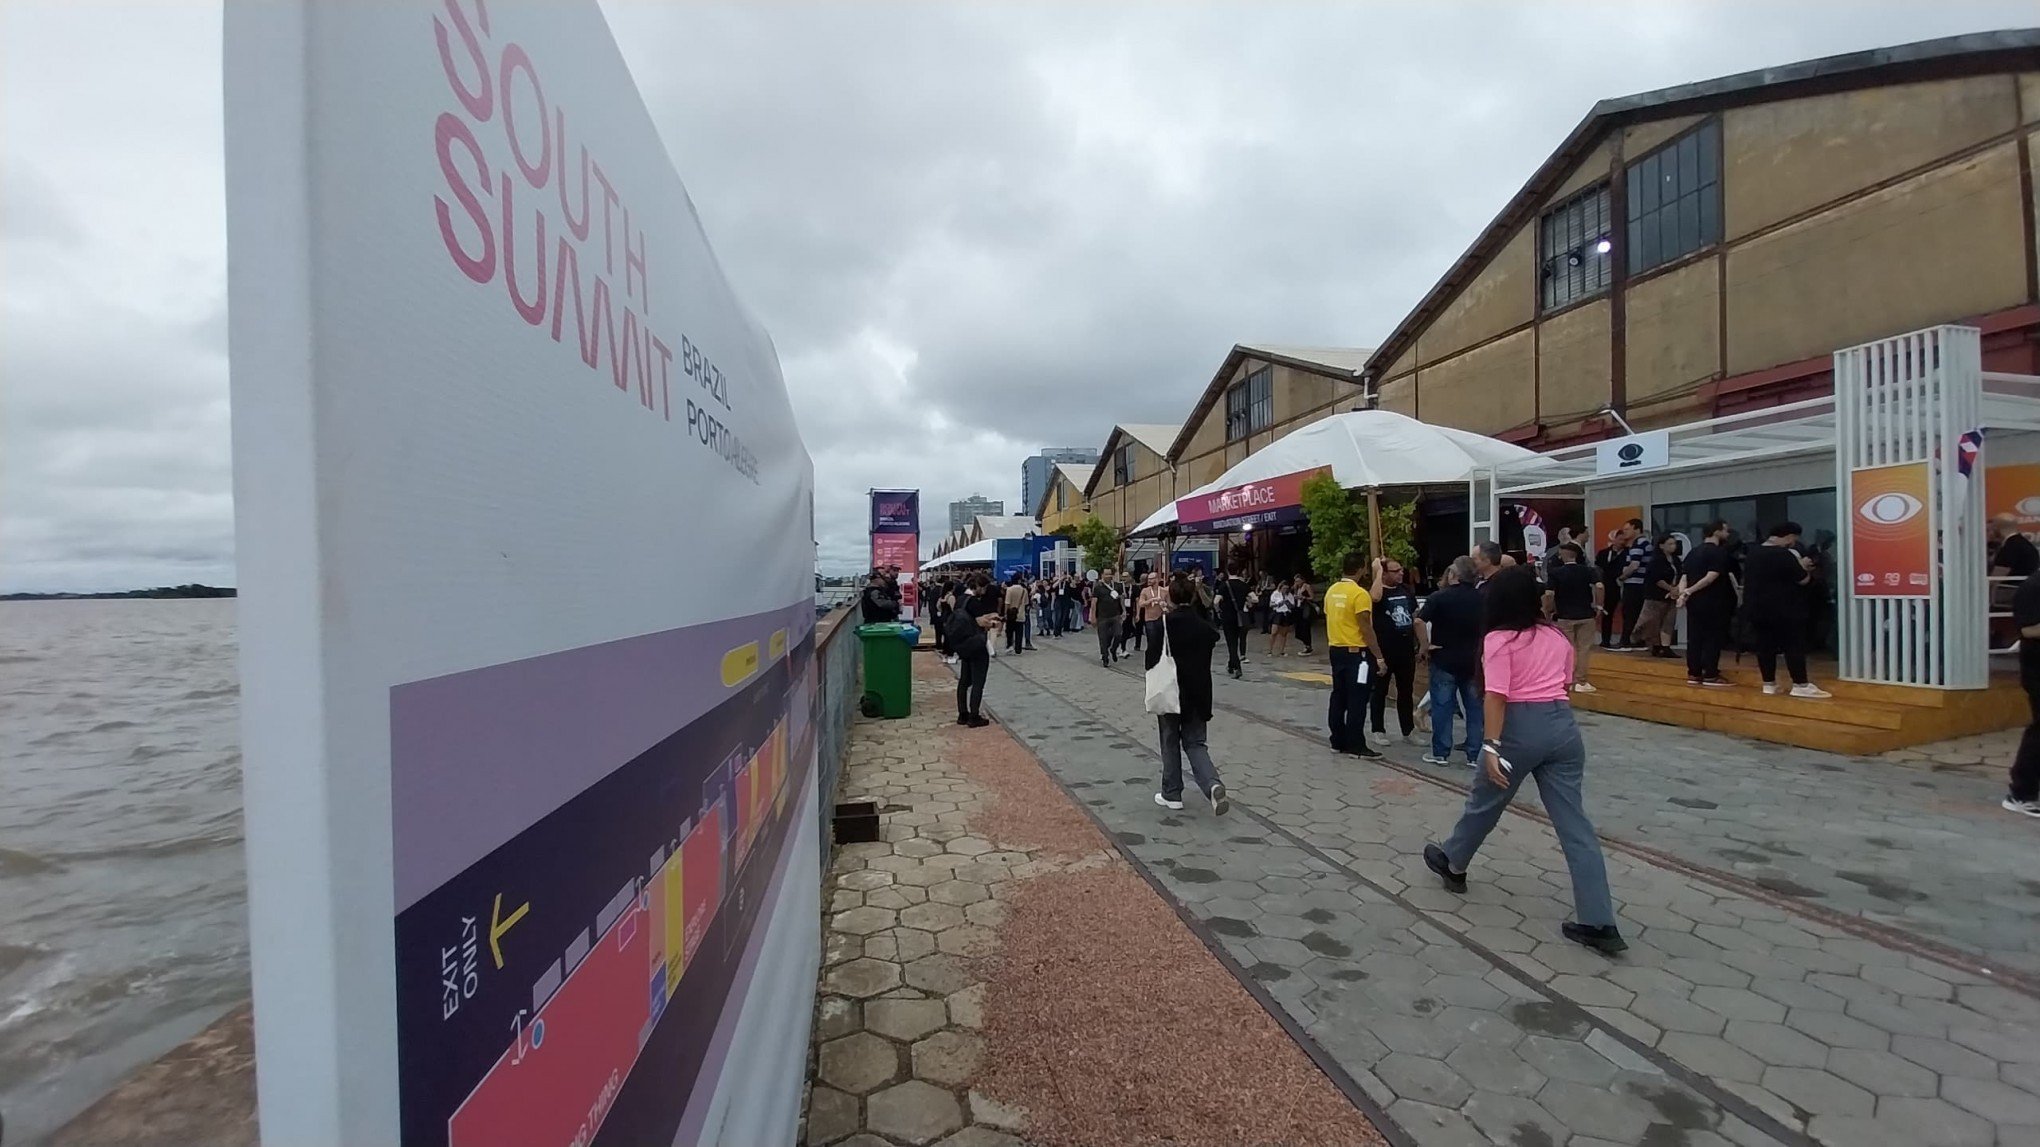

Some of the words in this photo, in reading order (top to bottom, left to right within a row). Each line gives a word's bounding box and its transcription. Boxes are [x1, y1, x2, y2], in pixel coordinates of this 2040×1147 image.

[433, 0, 648, 316] SOUTH
[433, 111, 673, 422] SUMMIT
[682, 333, 731, 412] BRAZIL
[686, 397, 731, 462] PORTO
[1208, 486, 1275, 513] MARKETPLACE
[1264, 511, 1277, 522] EXIT
[441, 945, 459, 1021] EXIT
[461, 915, 478, 999] ONLY
[587, 1067, 619, 1131] THING
